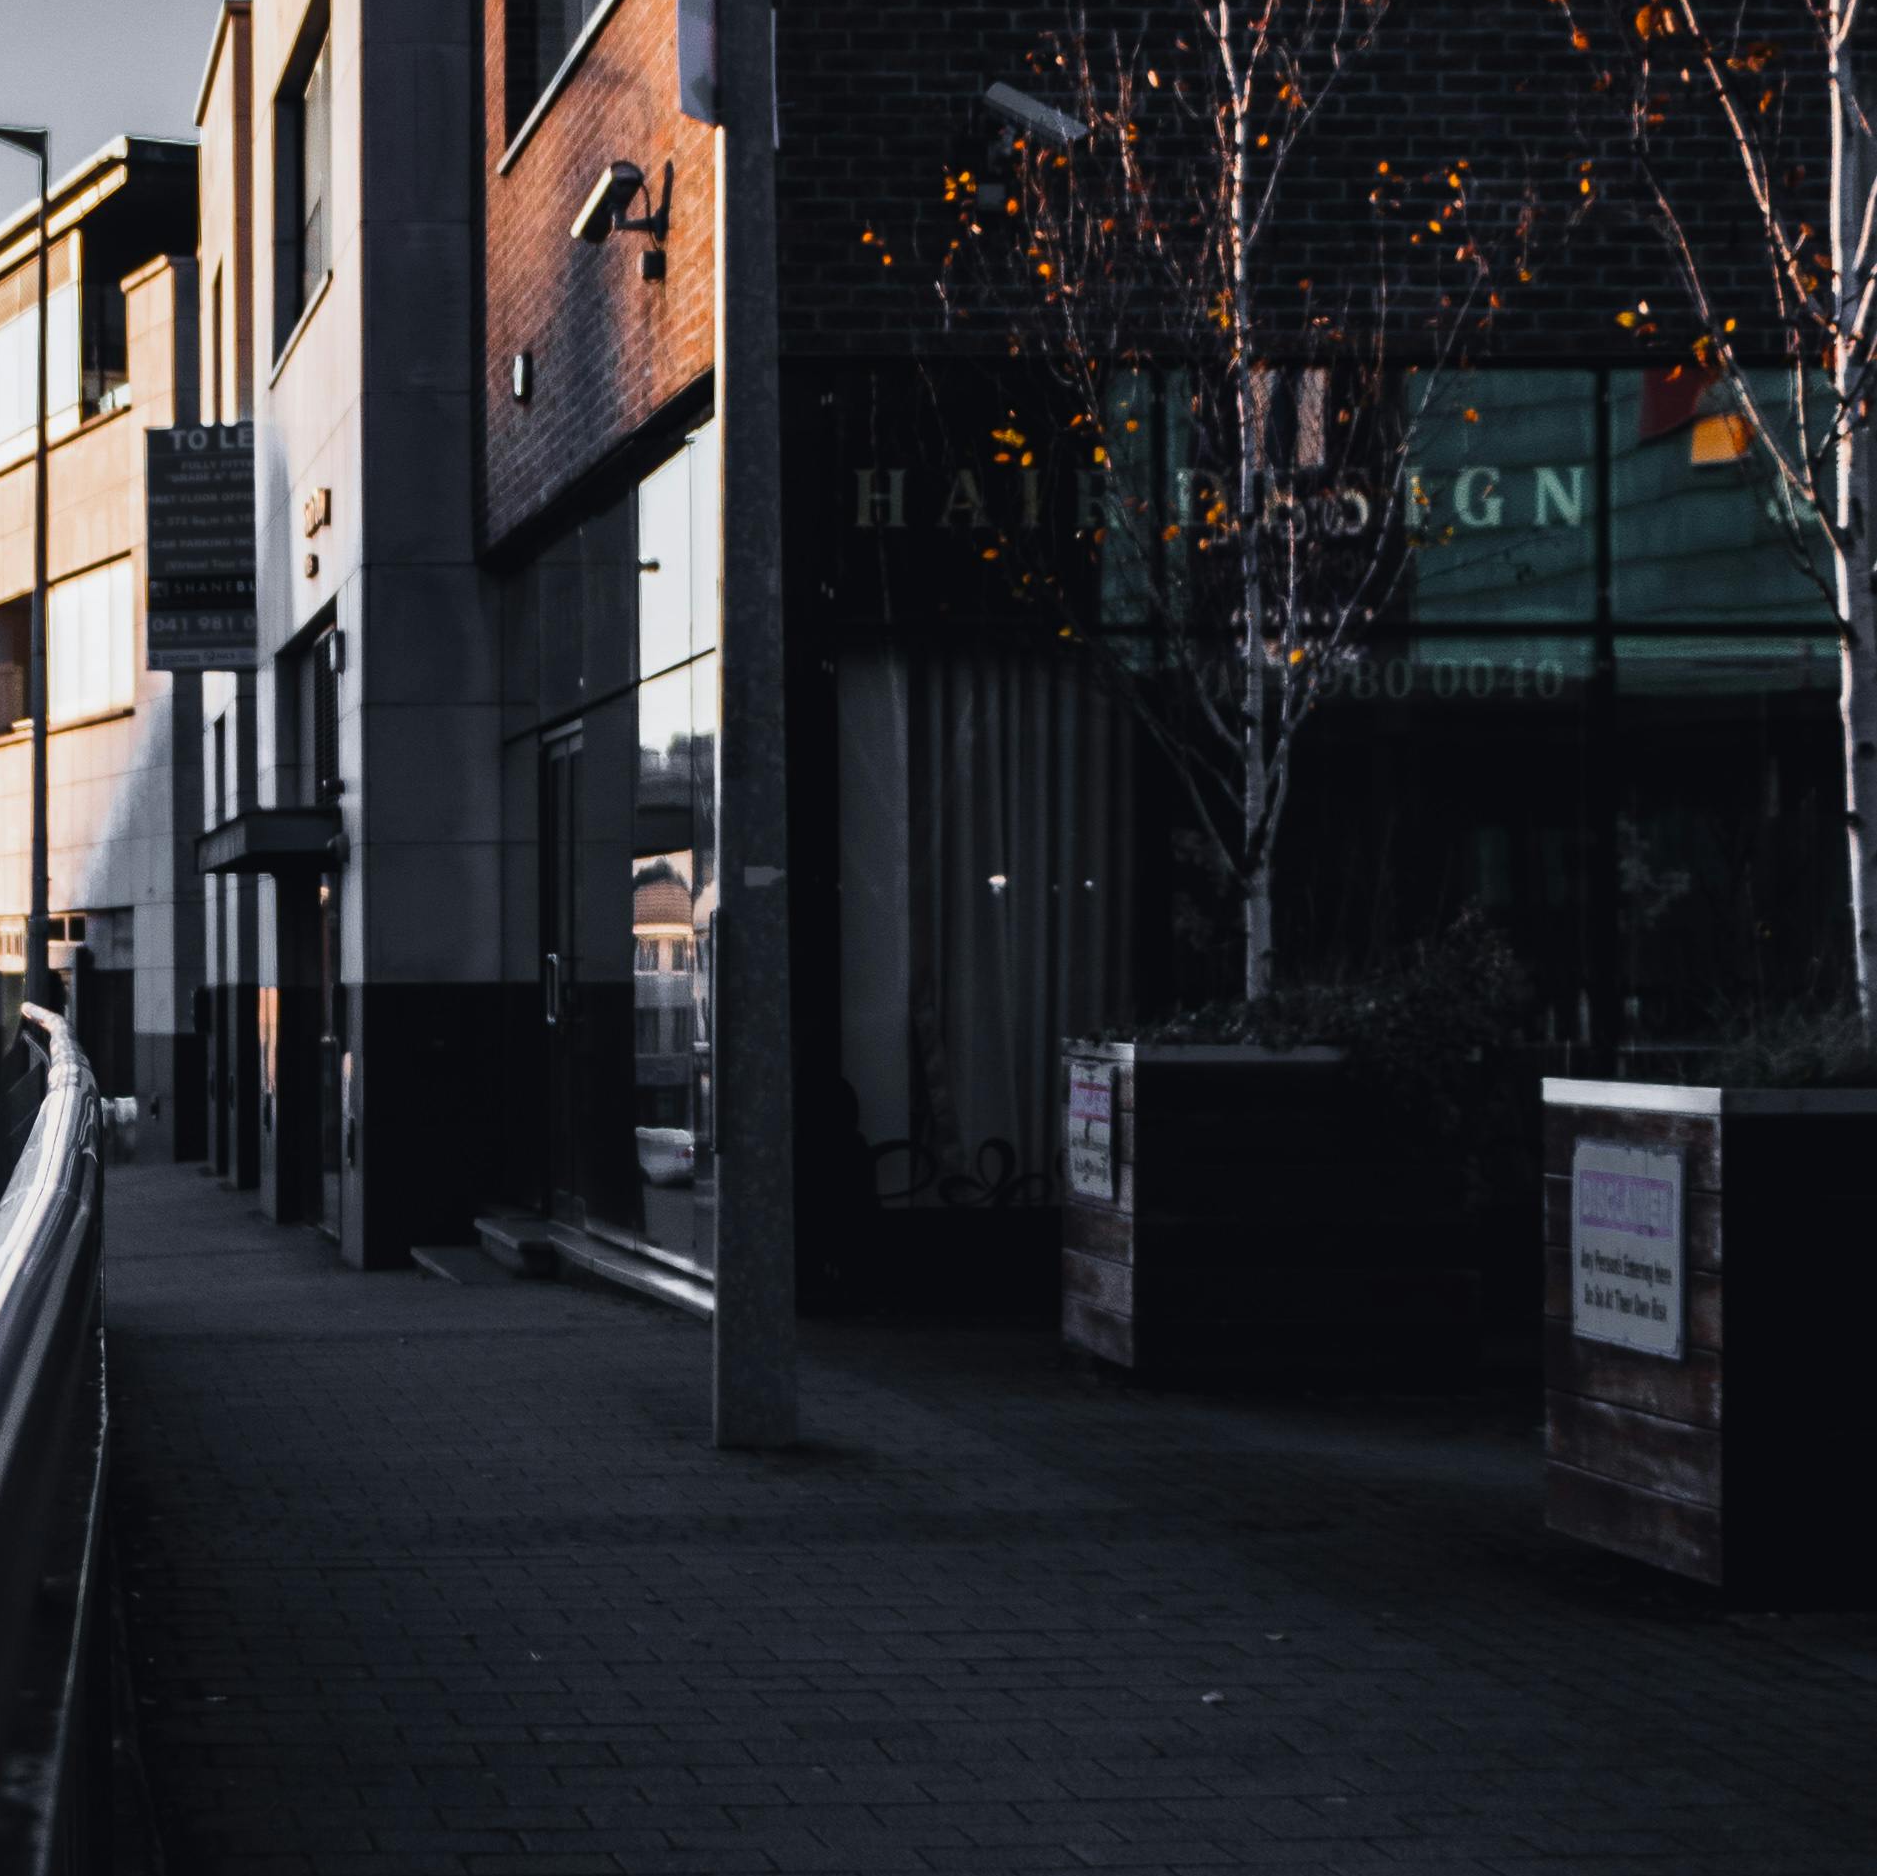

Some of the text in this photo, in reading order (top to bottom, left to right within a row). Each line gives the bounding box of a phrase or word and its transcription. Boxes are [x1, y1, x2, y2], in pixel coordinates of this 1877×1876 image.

[169, 428, 209, 452] TO
[854, 468, 1122, 528] HAIR
[1176, 466, 1586, 527] DIGN
[179, 537, 231, 549] PARKING
[152, 616, 189, 632] 041
[197, 615, 234, 631] 981
[1432, 657, 1565, 700] 0040
